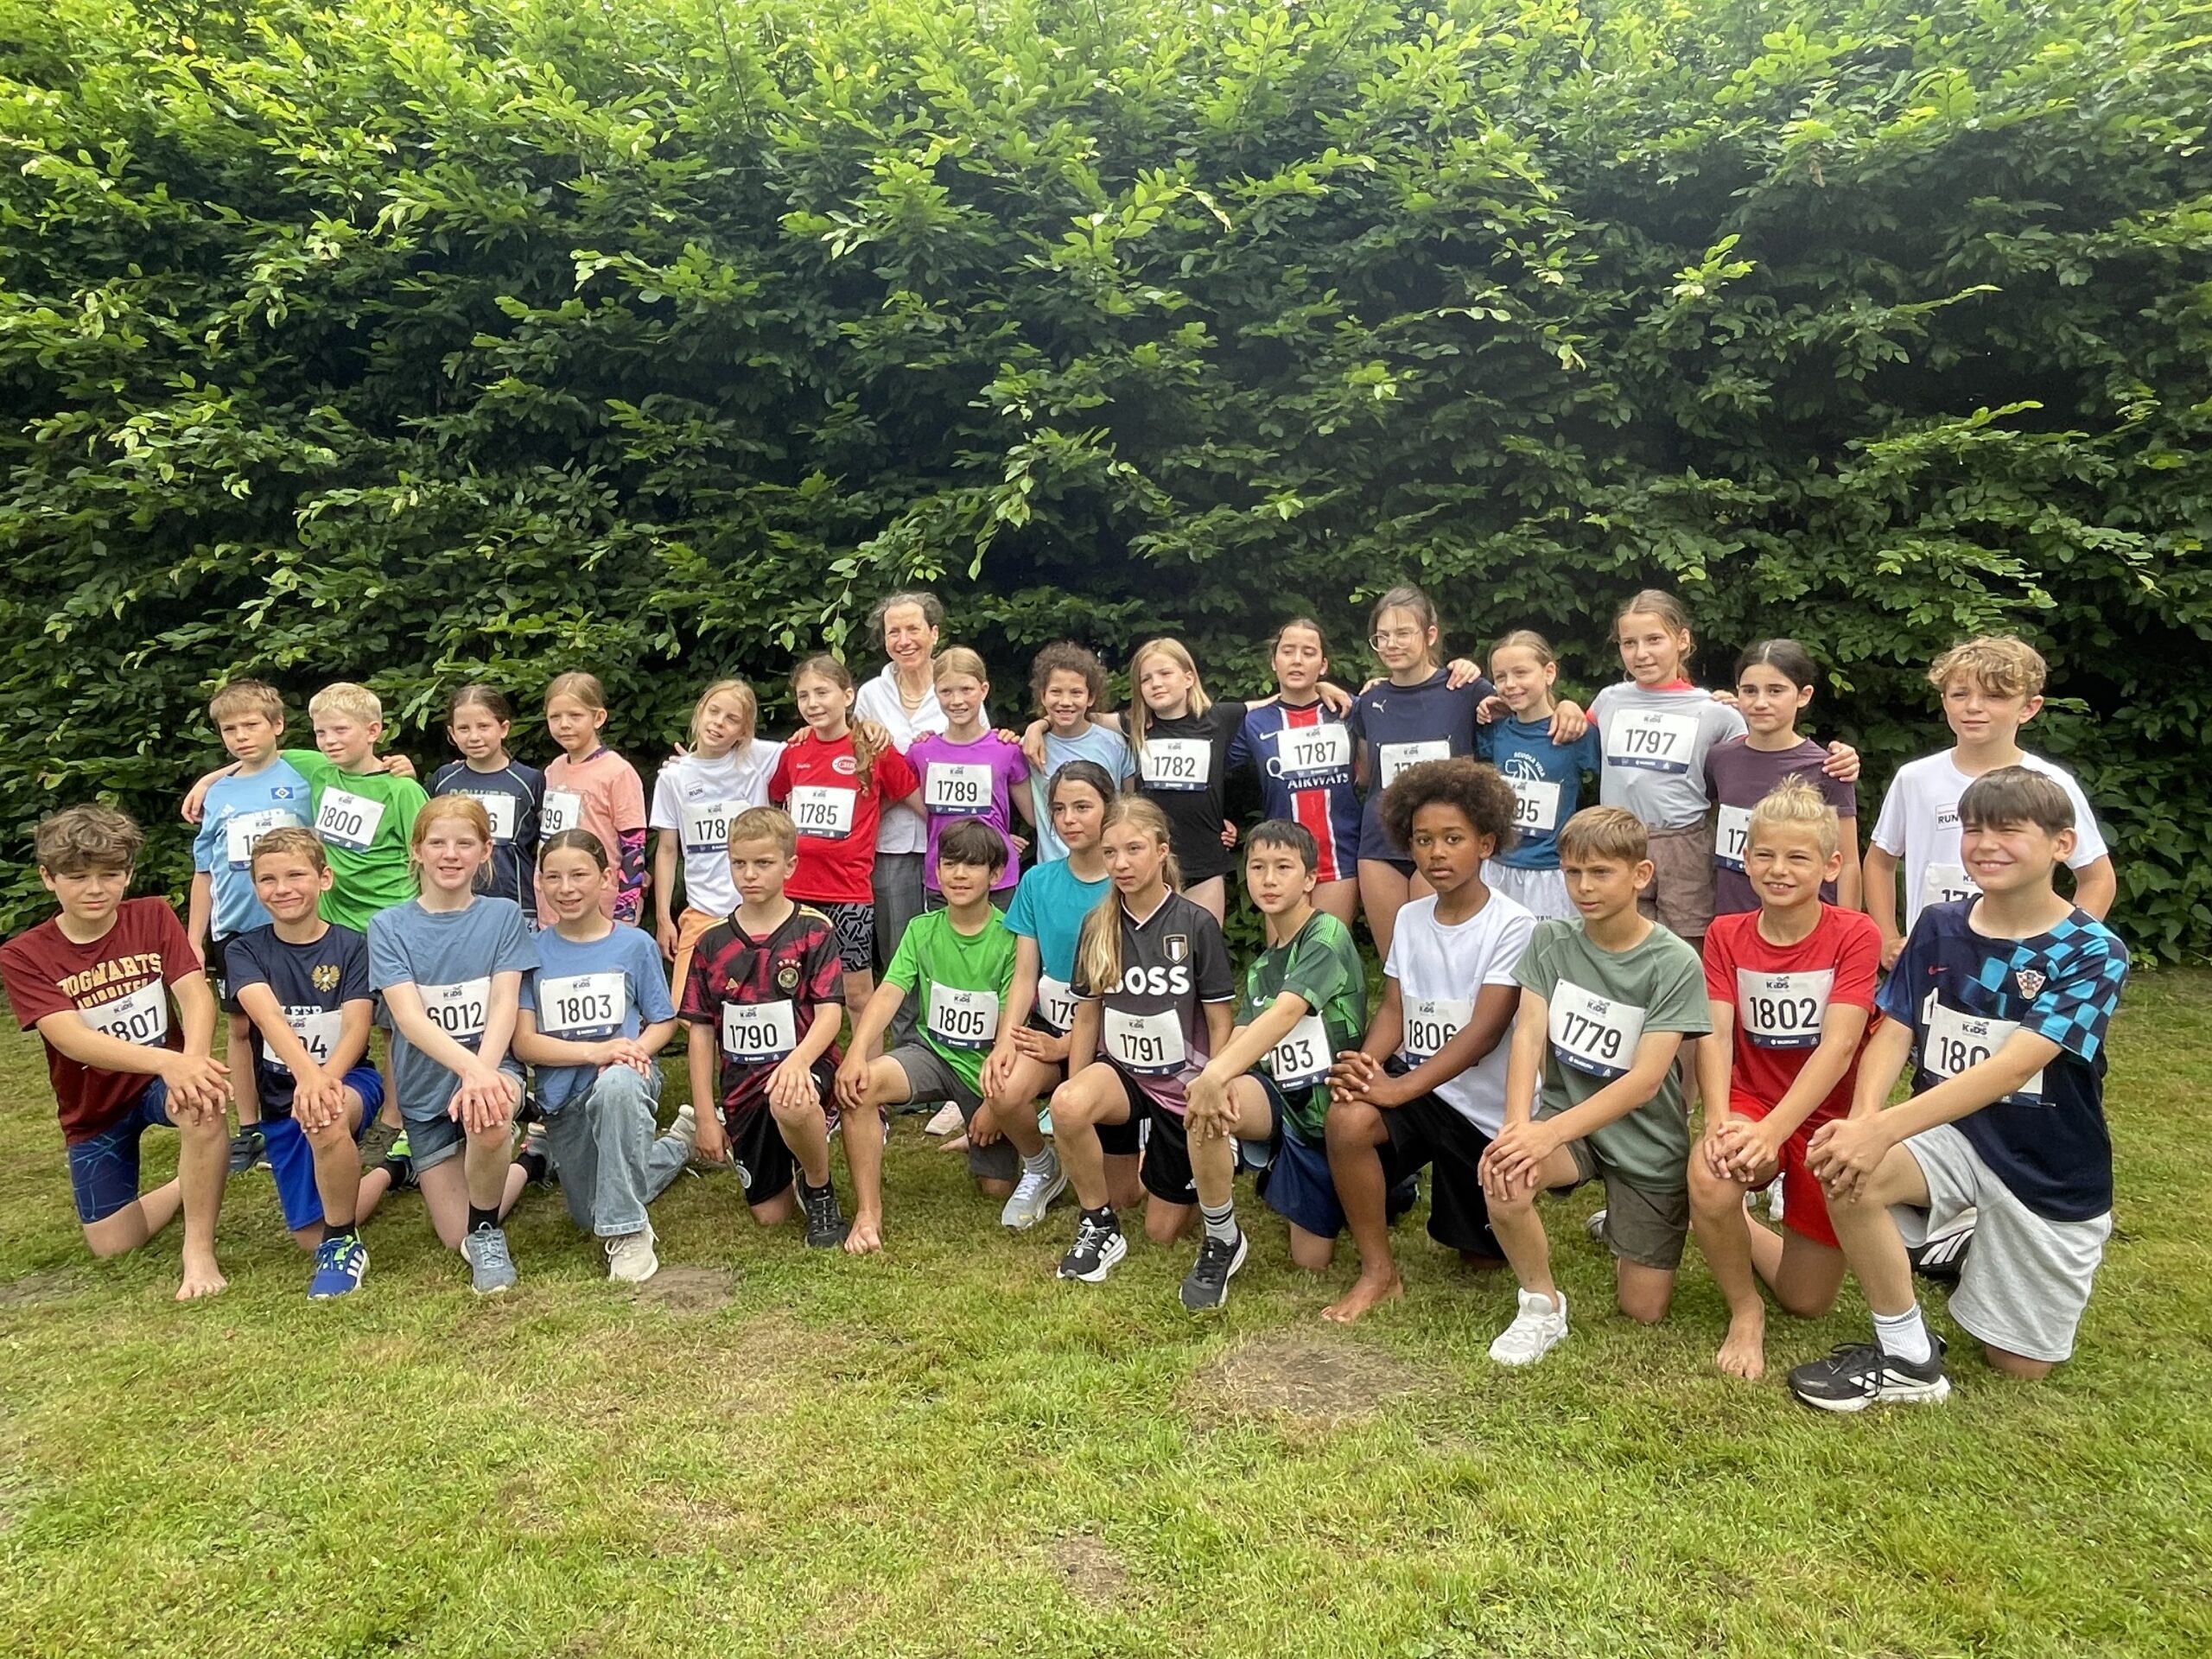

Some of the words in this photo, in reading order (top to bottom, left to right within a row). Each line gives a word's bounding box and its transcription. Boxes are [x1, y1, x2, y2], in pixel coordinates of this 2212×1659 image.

[1294, 741, 1336, 766] 1787
[1625, 728, 1676, 755] 1797
[1154, 756, 1195, 778] 1782
[1287, 772, 1349, 789] AIRWAYS
[689, 788, 703, 797] RUN
[937, 780, 977, 802] 1789
[319, 805, 363, 836] 1800
[545, 808, 563, 830] 99
[800, 803, 838, 825] 1785
[1515, 798, 1540, 823] 95
[1937, 815, 1959, 823] RUN
[695, 817, 733, 841] 178
[1728, 828, 1747, 855] 17
[1103, 966, 1190, 995] OSS
[427, 1001, 484, 1031] 6012
[556, 995, 612, 1025] 1803
[939, 1006, 985, 1035] 1805
[1050, 999, 1078, 1024] 179
[1750, 996, 1820, 1029] 1802
[729, 1023, 778, 1049] 1790
[1120, 1034, 1164, 1062] 1791
[1408, 1020, 1457, 1051] 1806
[1562, 1012, 1621, 1058] 1779
[1271, 1039, 1313, 1075] 793
[1941, 1037, 1991, 1074] 180
